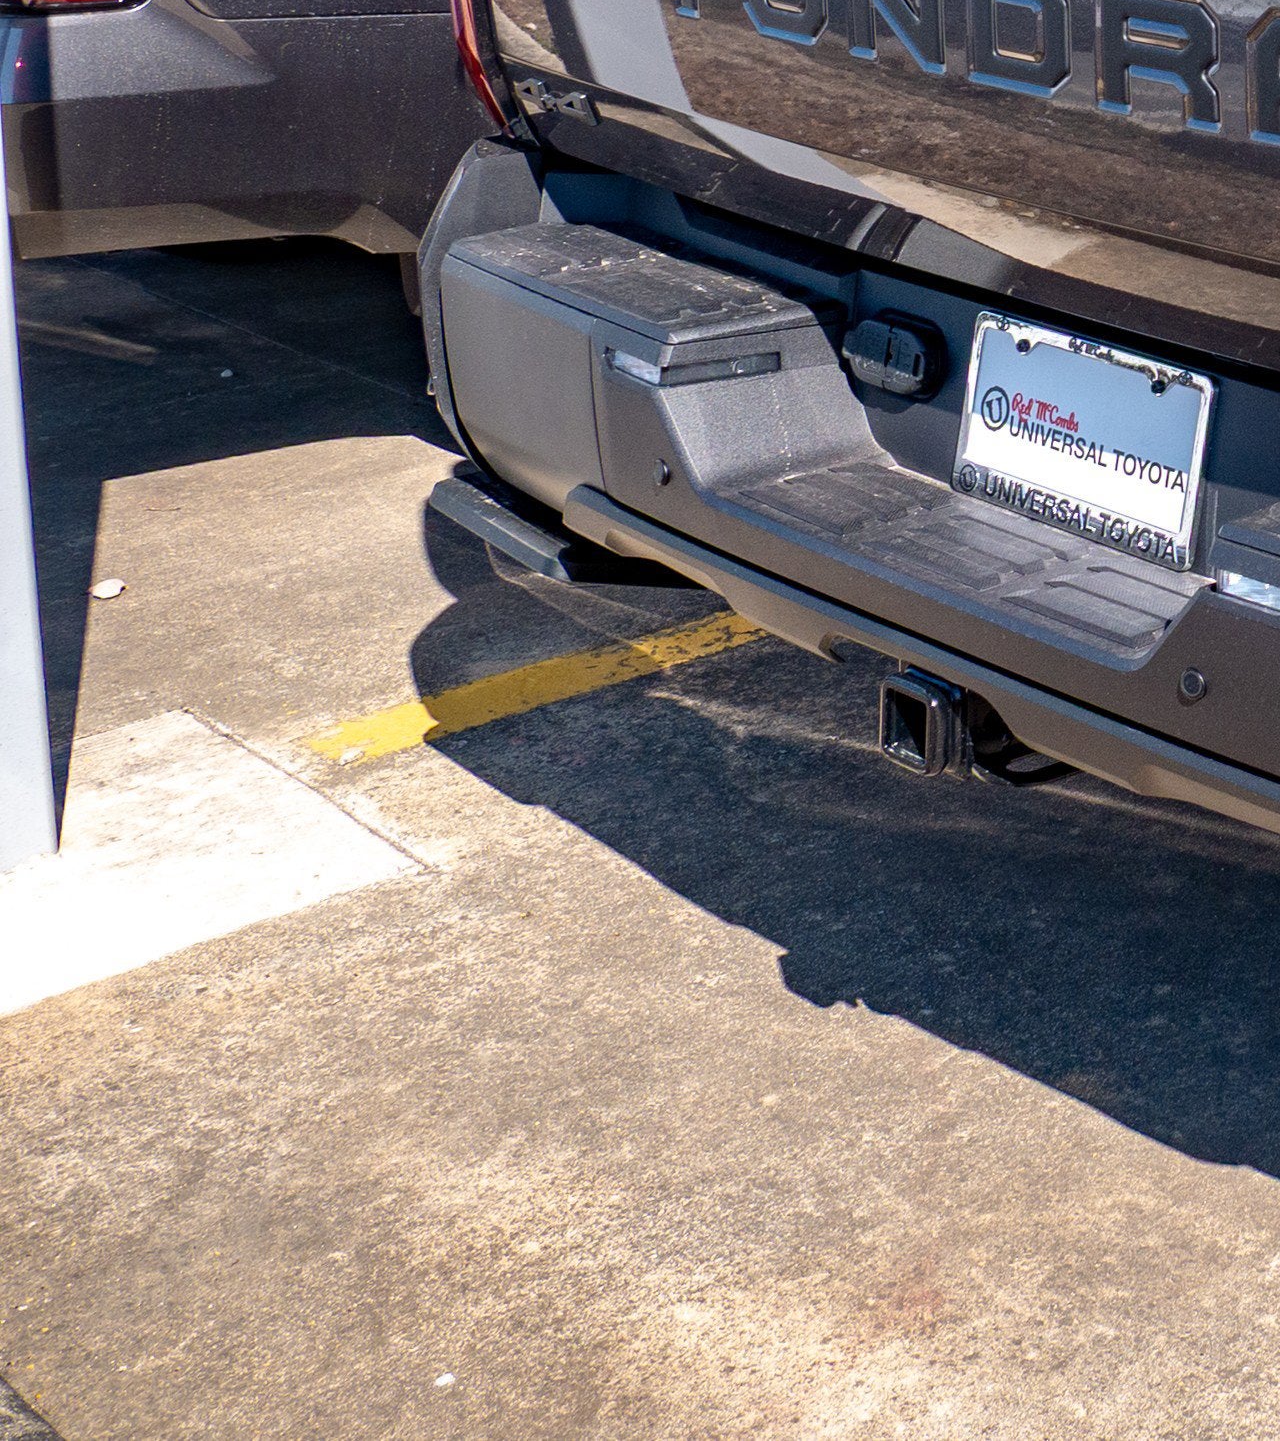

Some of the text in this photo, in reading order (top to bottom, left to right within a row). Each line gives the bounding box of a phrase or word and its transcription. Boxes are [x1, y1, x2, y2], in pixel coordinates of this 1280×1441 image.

[1011, 392, 1080, 433] Red McCombs
[1009, 415, 1185, 493] UNIVERSAL TOYOTA
[984, 471, 1179, 564] UNIVERSAL TOYOTA
